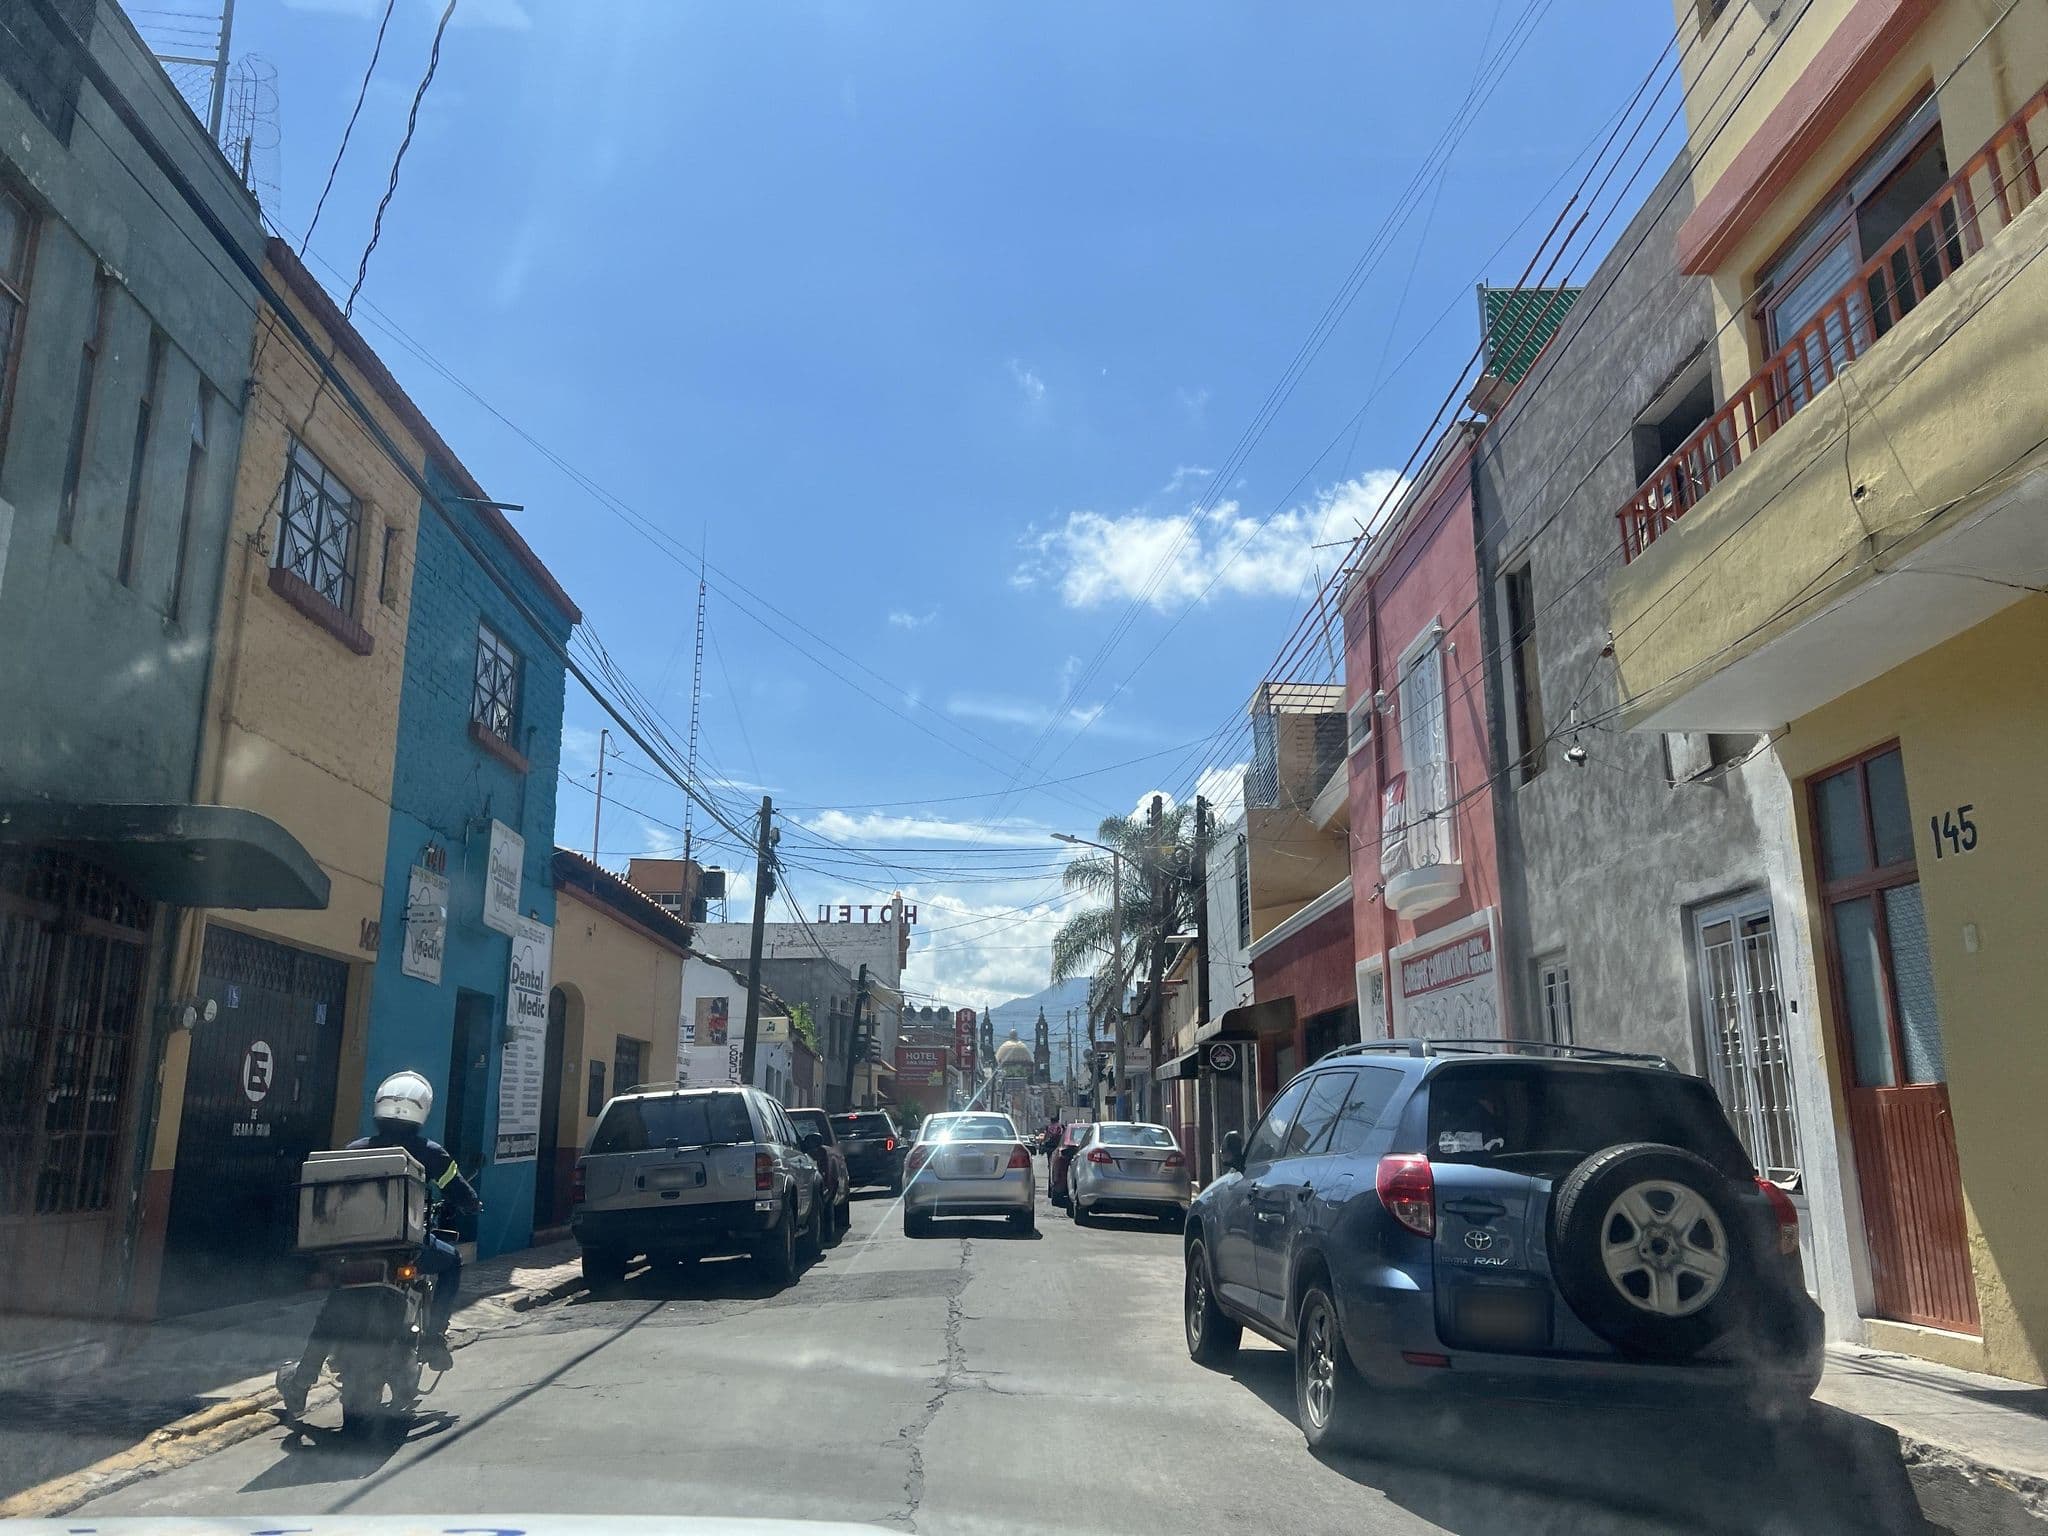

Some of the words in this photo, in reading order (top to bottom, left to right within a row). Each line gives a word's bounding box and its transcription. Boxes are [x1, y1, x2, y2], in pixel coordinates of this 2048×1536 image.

[1930, 804, 1978, 859] 145
[491, 855, 518, 885] Dental
[496, 884, 517, 912] Medic
[511, 961, 544, 991] Dental
[518, 993, 545, 1019] Medic
[961, 1010, 972, 1068] HOTEL
[905, 1052, 938, 1060] HOTEL
